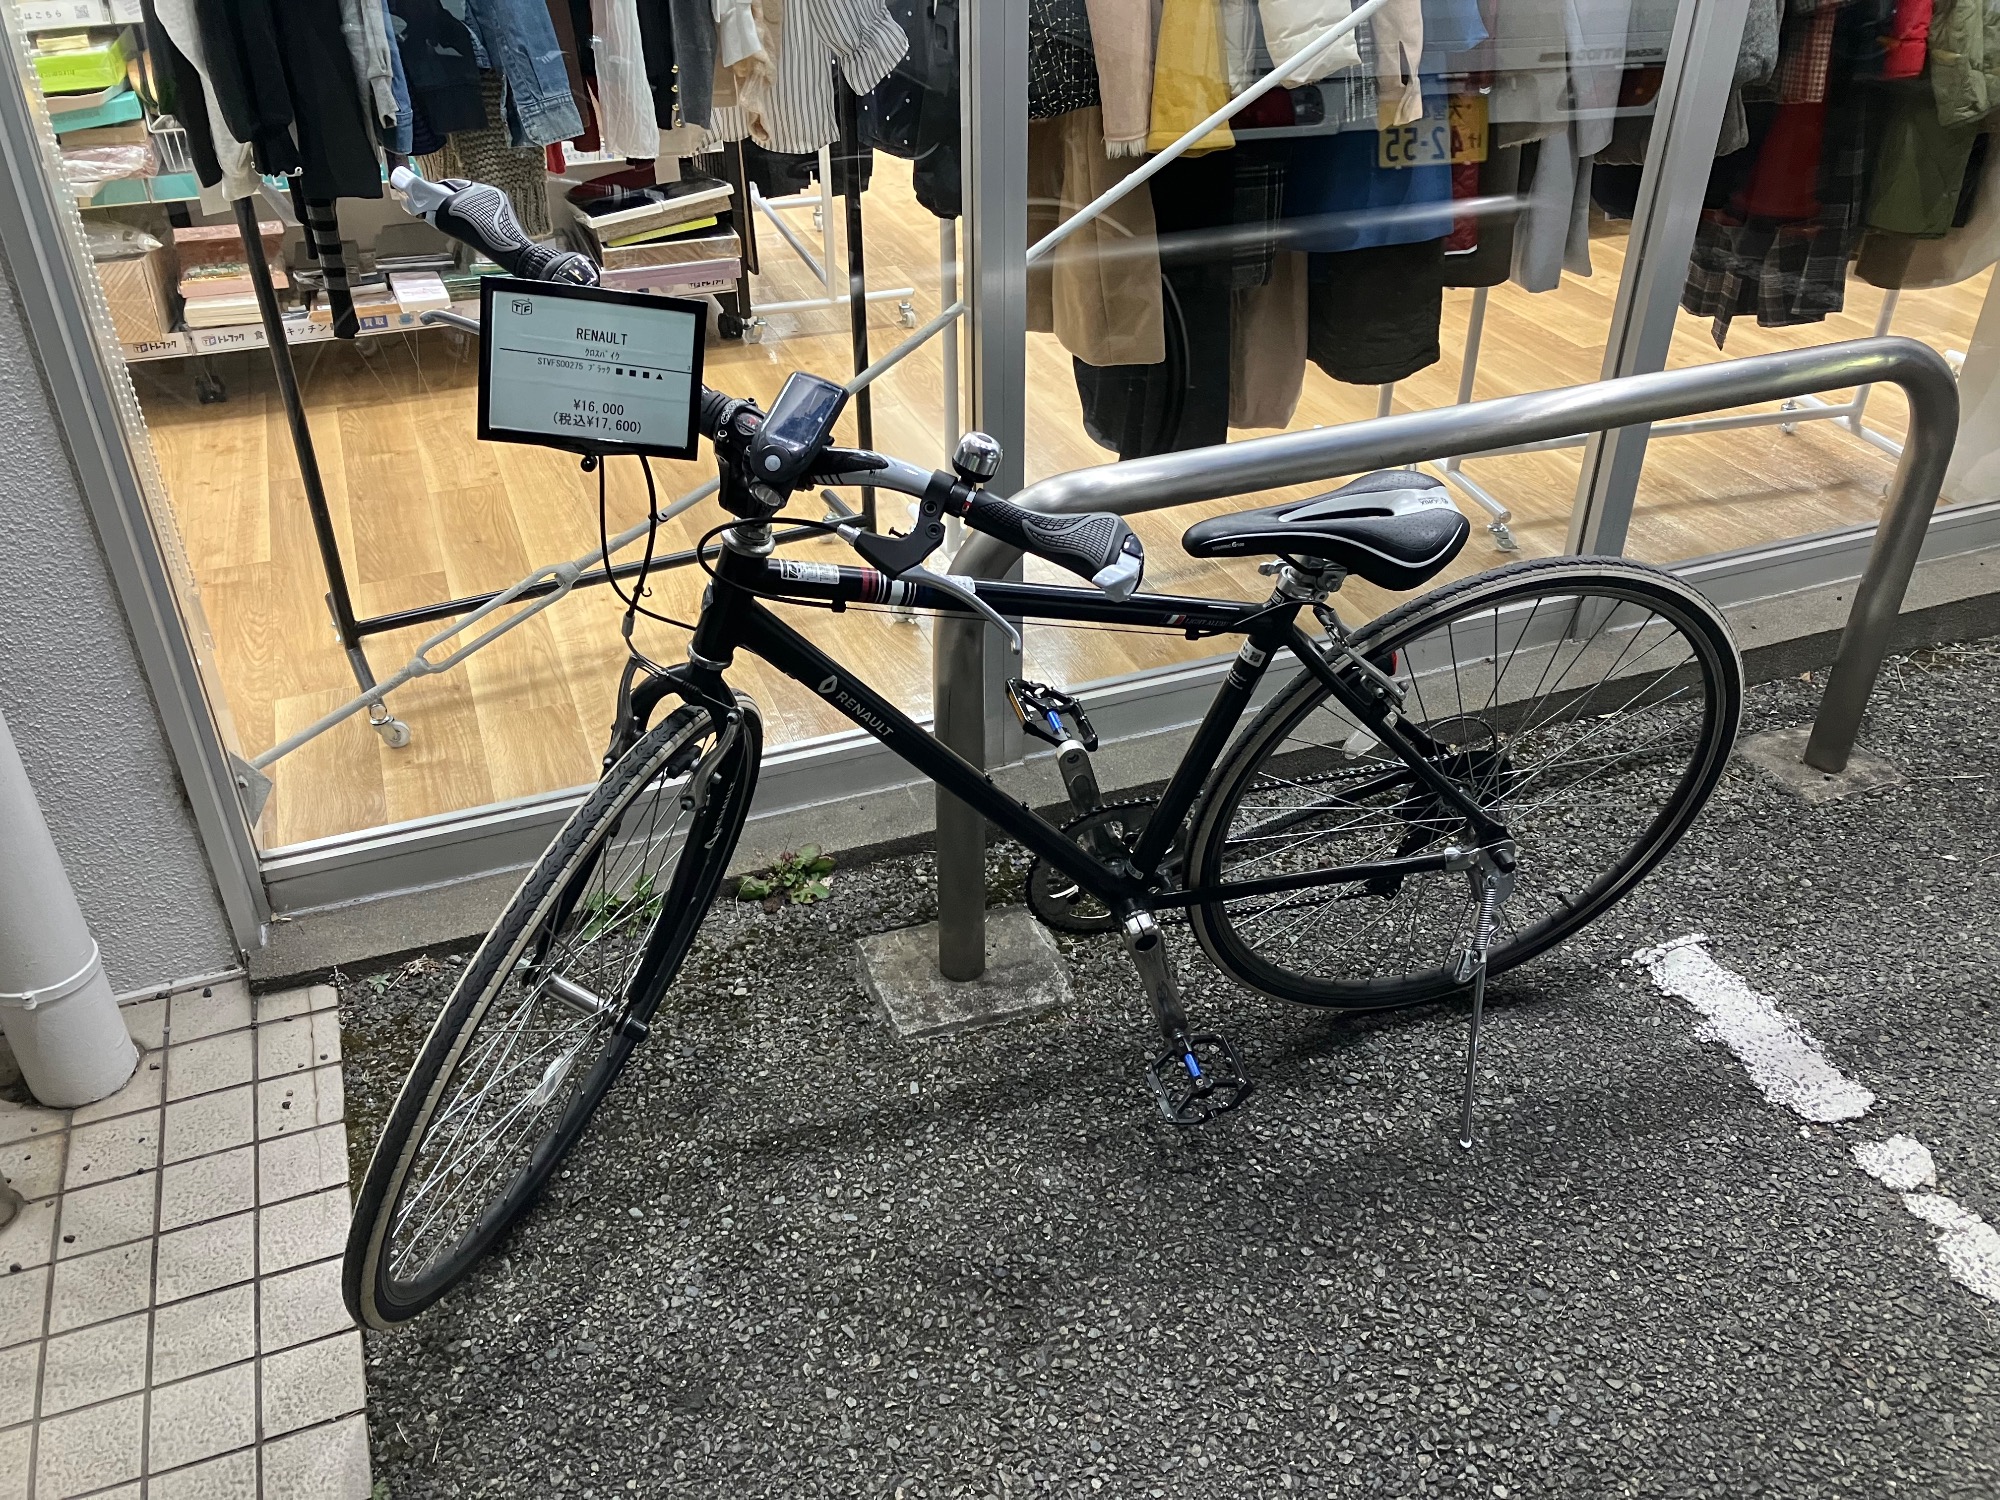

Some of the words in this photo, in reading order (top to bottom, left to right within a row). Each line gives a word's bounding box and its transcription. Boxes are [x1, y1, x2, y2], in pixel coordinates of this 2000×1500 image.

[576, 327, 628, 346] RENAULT
[573, 398, 624, 416] ¥16,000
[553, 411, 642, 434] (税込¥17,600)
[835, 691, 894, 736] RENAULT
